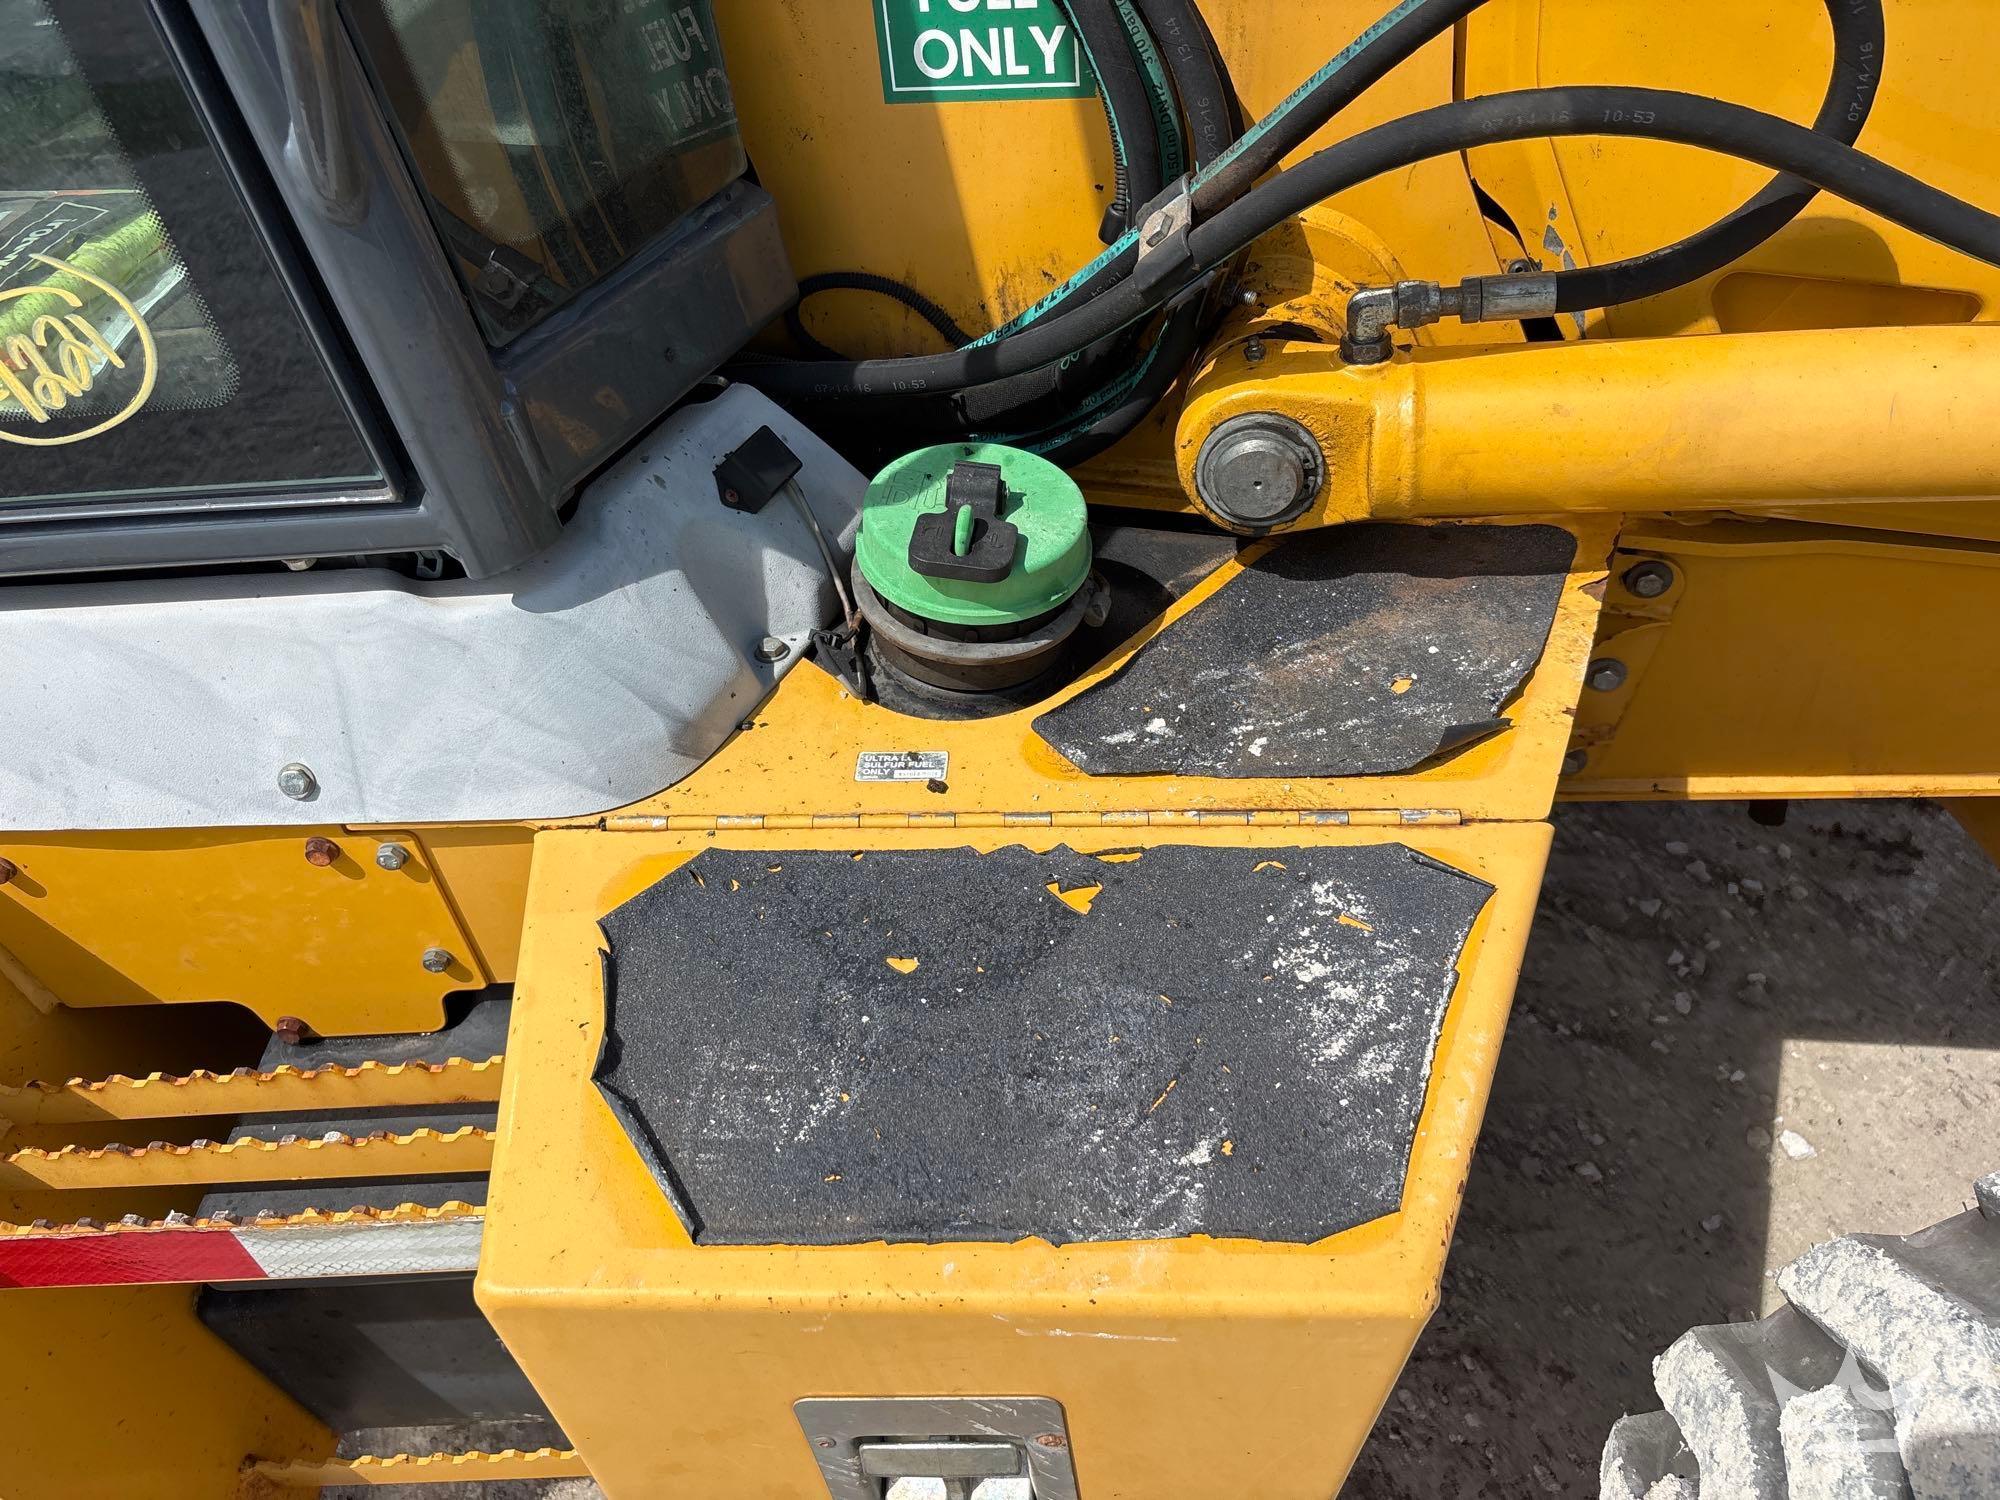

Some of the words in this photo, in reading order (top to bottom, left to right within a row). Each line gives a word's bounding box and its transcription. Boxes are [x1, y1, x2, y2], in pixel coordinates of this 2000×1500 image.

[913, 25, 1067, 79] ONLY
[1136, 39, 1154, 65] 310
[1846, 41, 1873, 122] 07/14/16
[1602, 109, 1656, 124] 10:53
[1196, 97, 1219, 160] 8/03/16
[893, 379, 927, 391] 10:53
[863, 761, 906, 769] SULFUR
[908, 761, 935, 769] FUEL
[864, 754, 899, 762] ULTRA
[862, 768, 891, 776] ONLY
